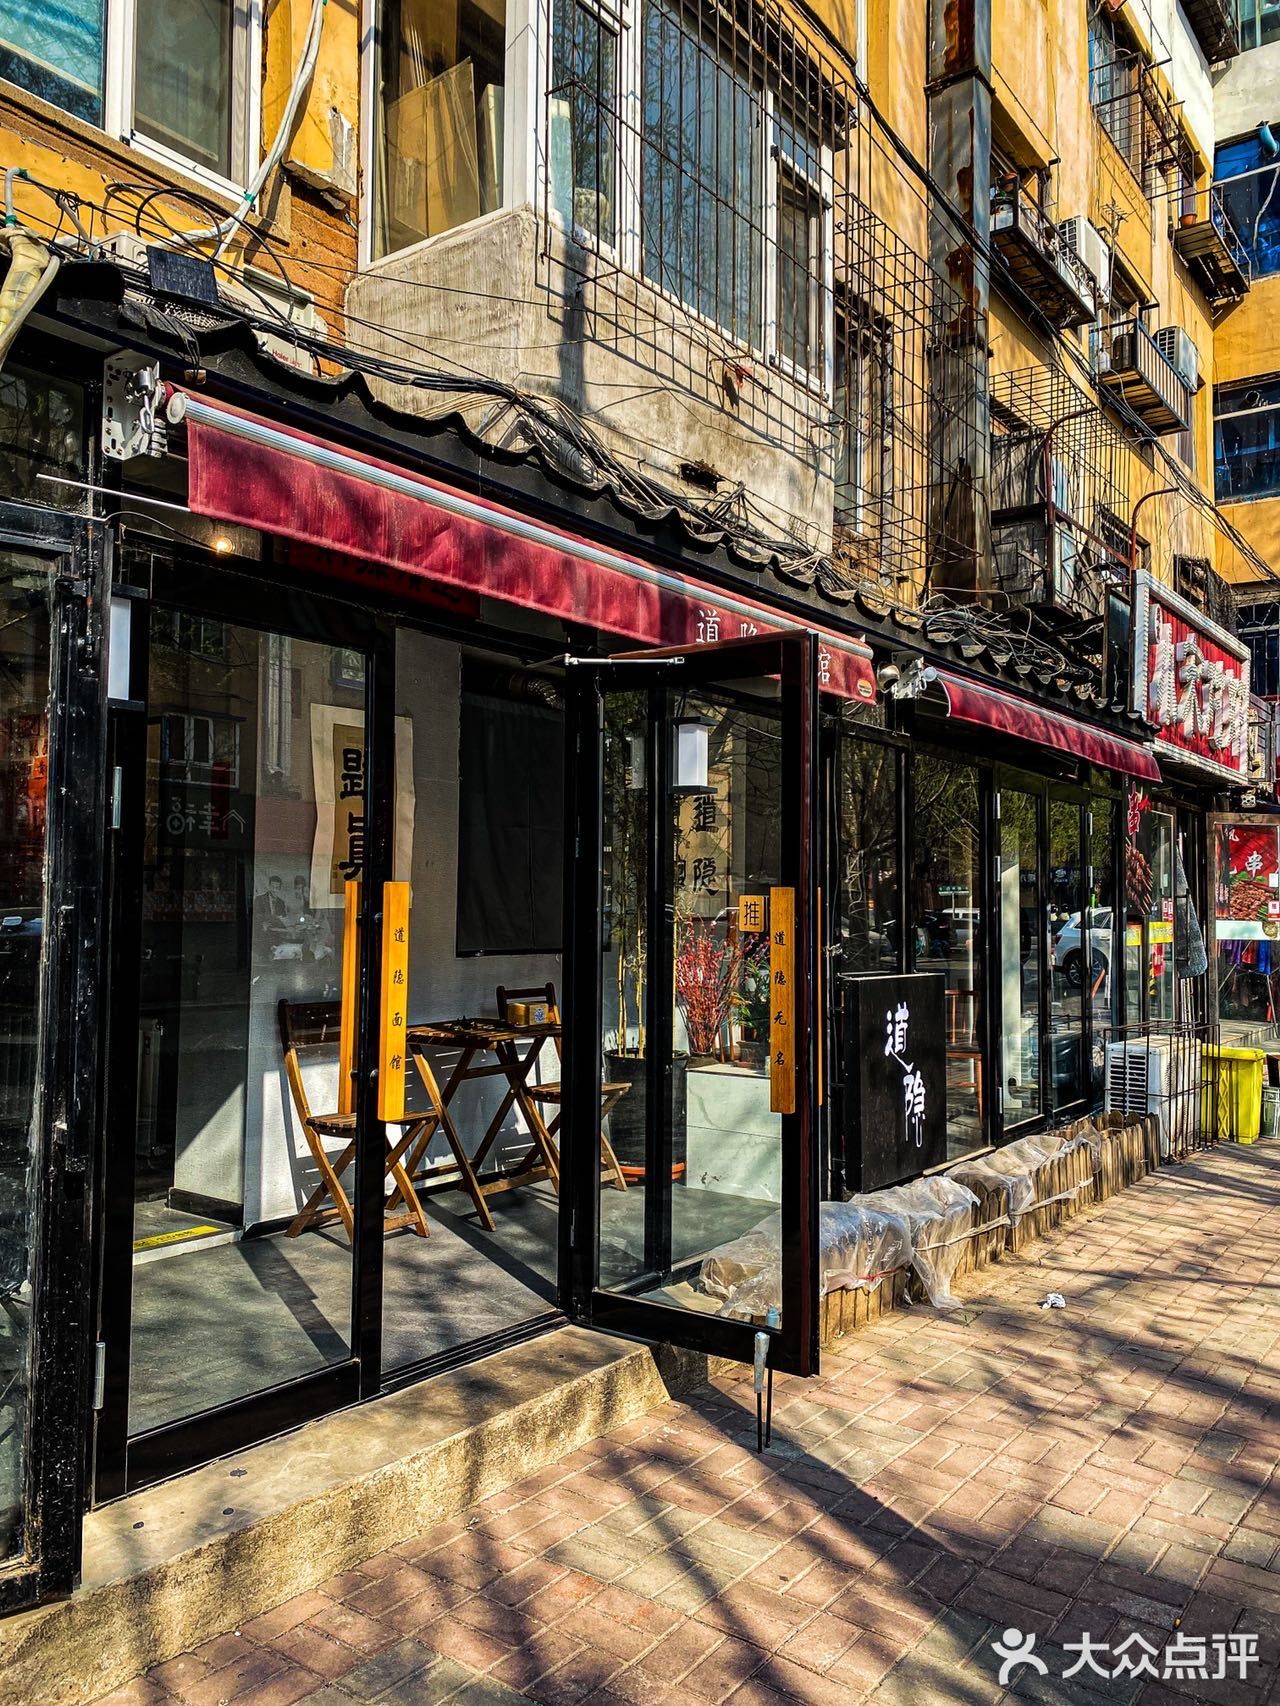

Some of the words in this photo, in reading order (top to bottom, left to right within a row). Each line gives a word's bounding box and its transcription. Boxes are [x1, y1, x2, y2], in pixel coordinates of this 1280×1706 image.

[743, 900, 760, 927] 推
[389, 927, 406, 1070] 道隐面馆
[773, 931, 787, 1067] 道隐无名
